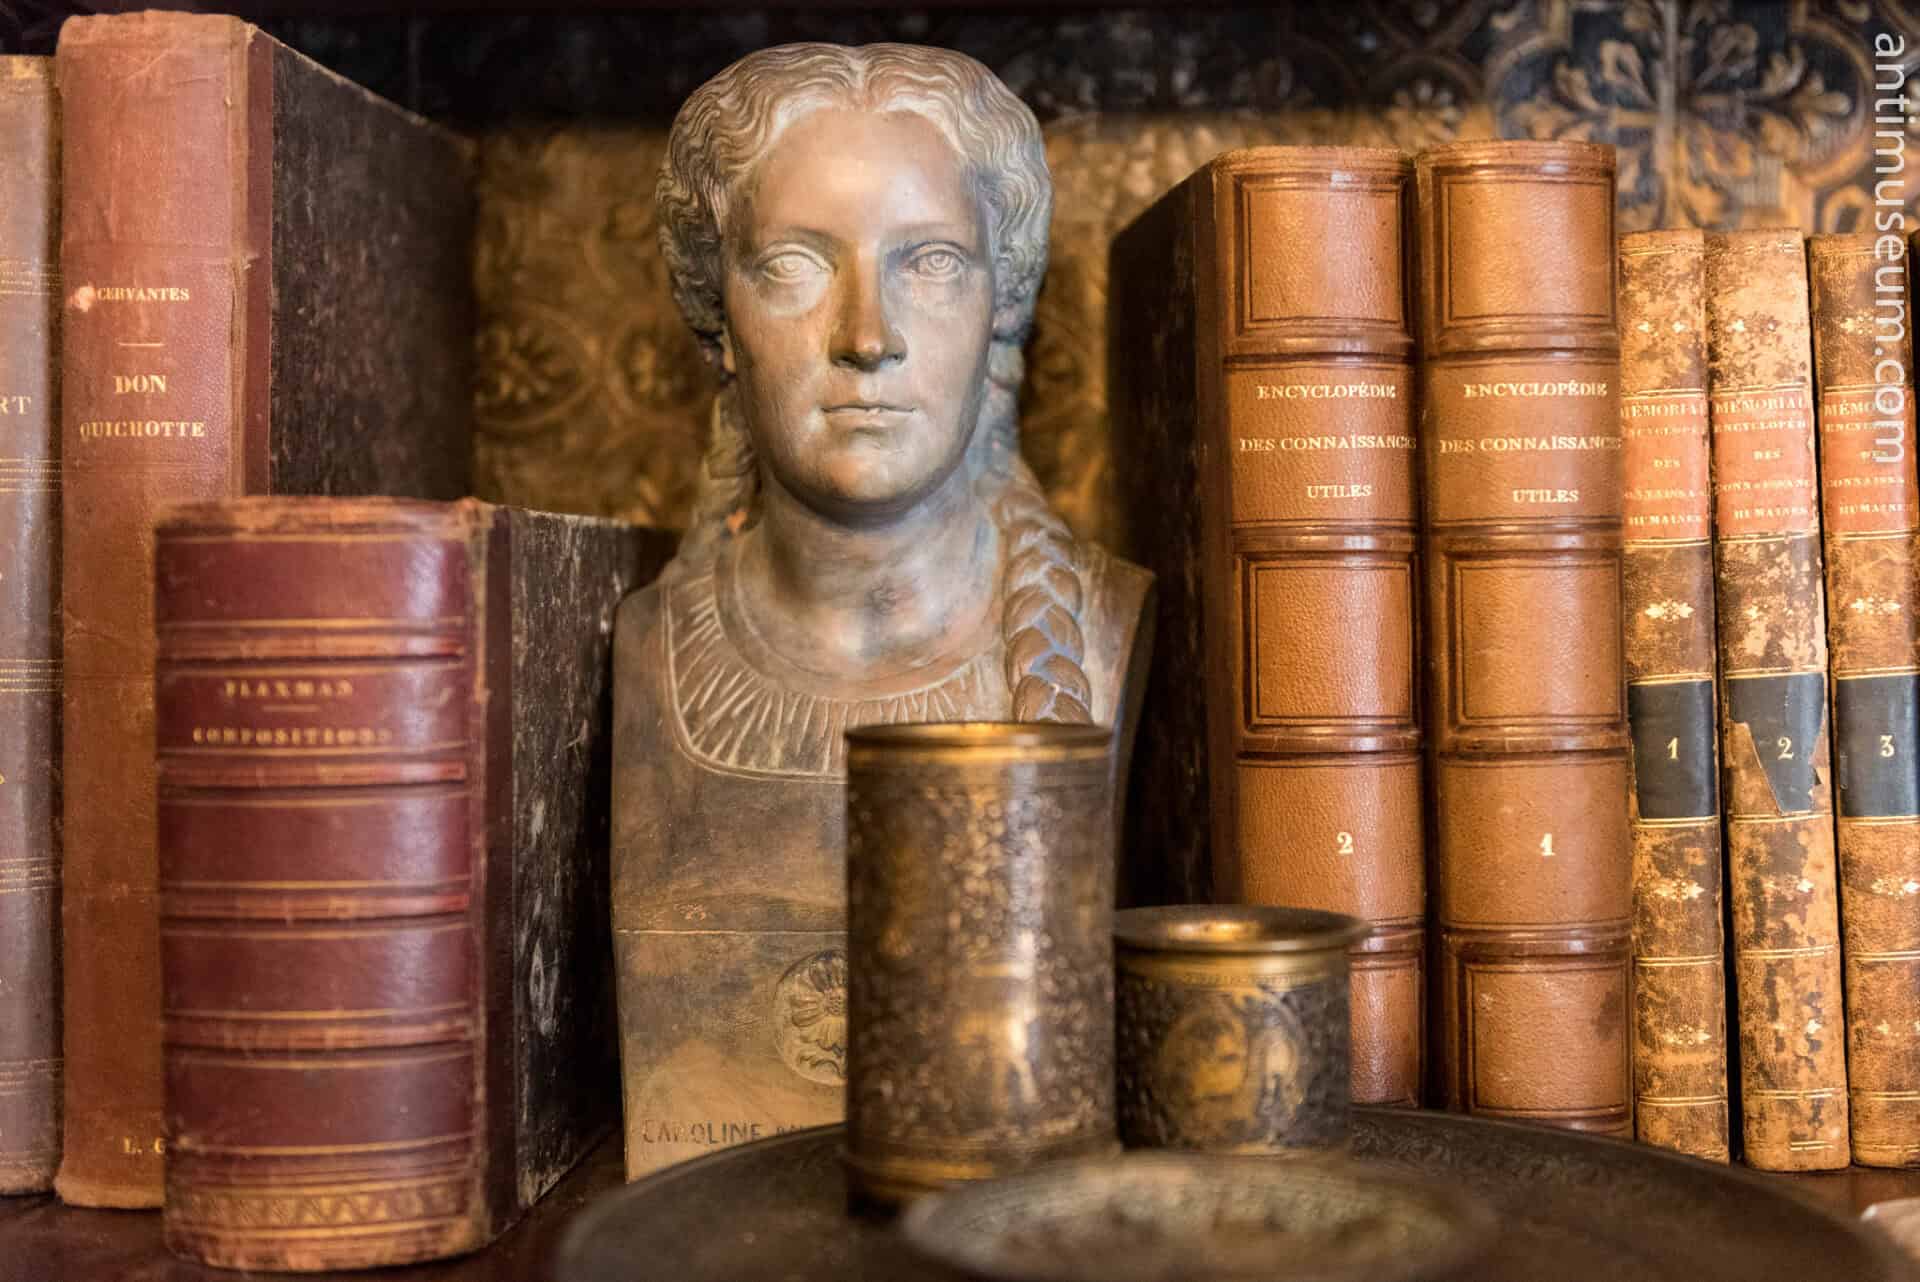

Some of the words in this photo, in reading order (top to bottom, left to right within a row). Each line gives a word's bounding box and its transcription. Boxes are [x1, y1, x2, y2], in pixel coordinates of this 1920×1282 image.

[97, 287, 190, 301] CERVANTES
[114, 375, 167, 394] DON
[1257, 381, 1396, 400] ENCYCLOPÉDIE
[1463, 379, 1608, 399] ENCYCLOPÉDIE
[80, 420, 206, 442] QUICHOTTE
[1239, 437, 1276, 452] DES
[1440, 439, 1475, 453] DES
[1307, 484, 1372, 499] UTILES
[1511, 489, 1580, 504] UTILES
[1666, 738, 1680, 761] 1
[1776, 738, 1795, 761] 2
[1879, 734, 1895, 758] 3
[1336, 831, 1355, 856] 2
[1539, 833, 1556, 857] 1
